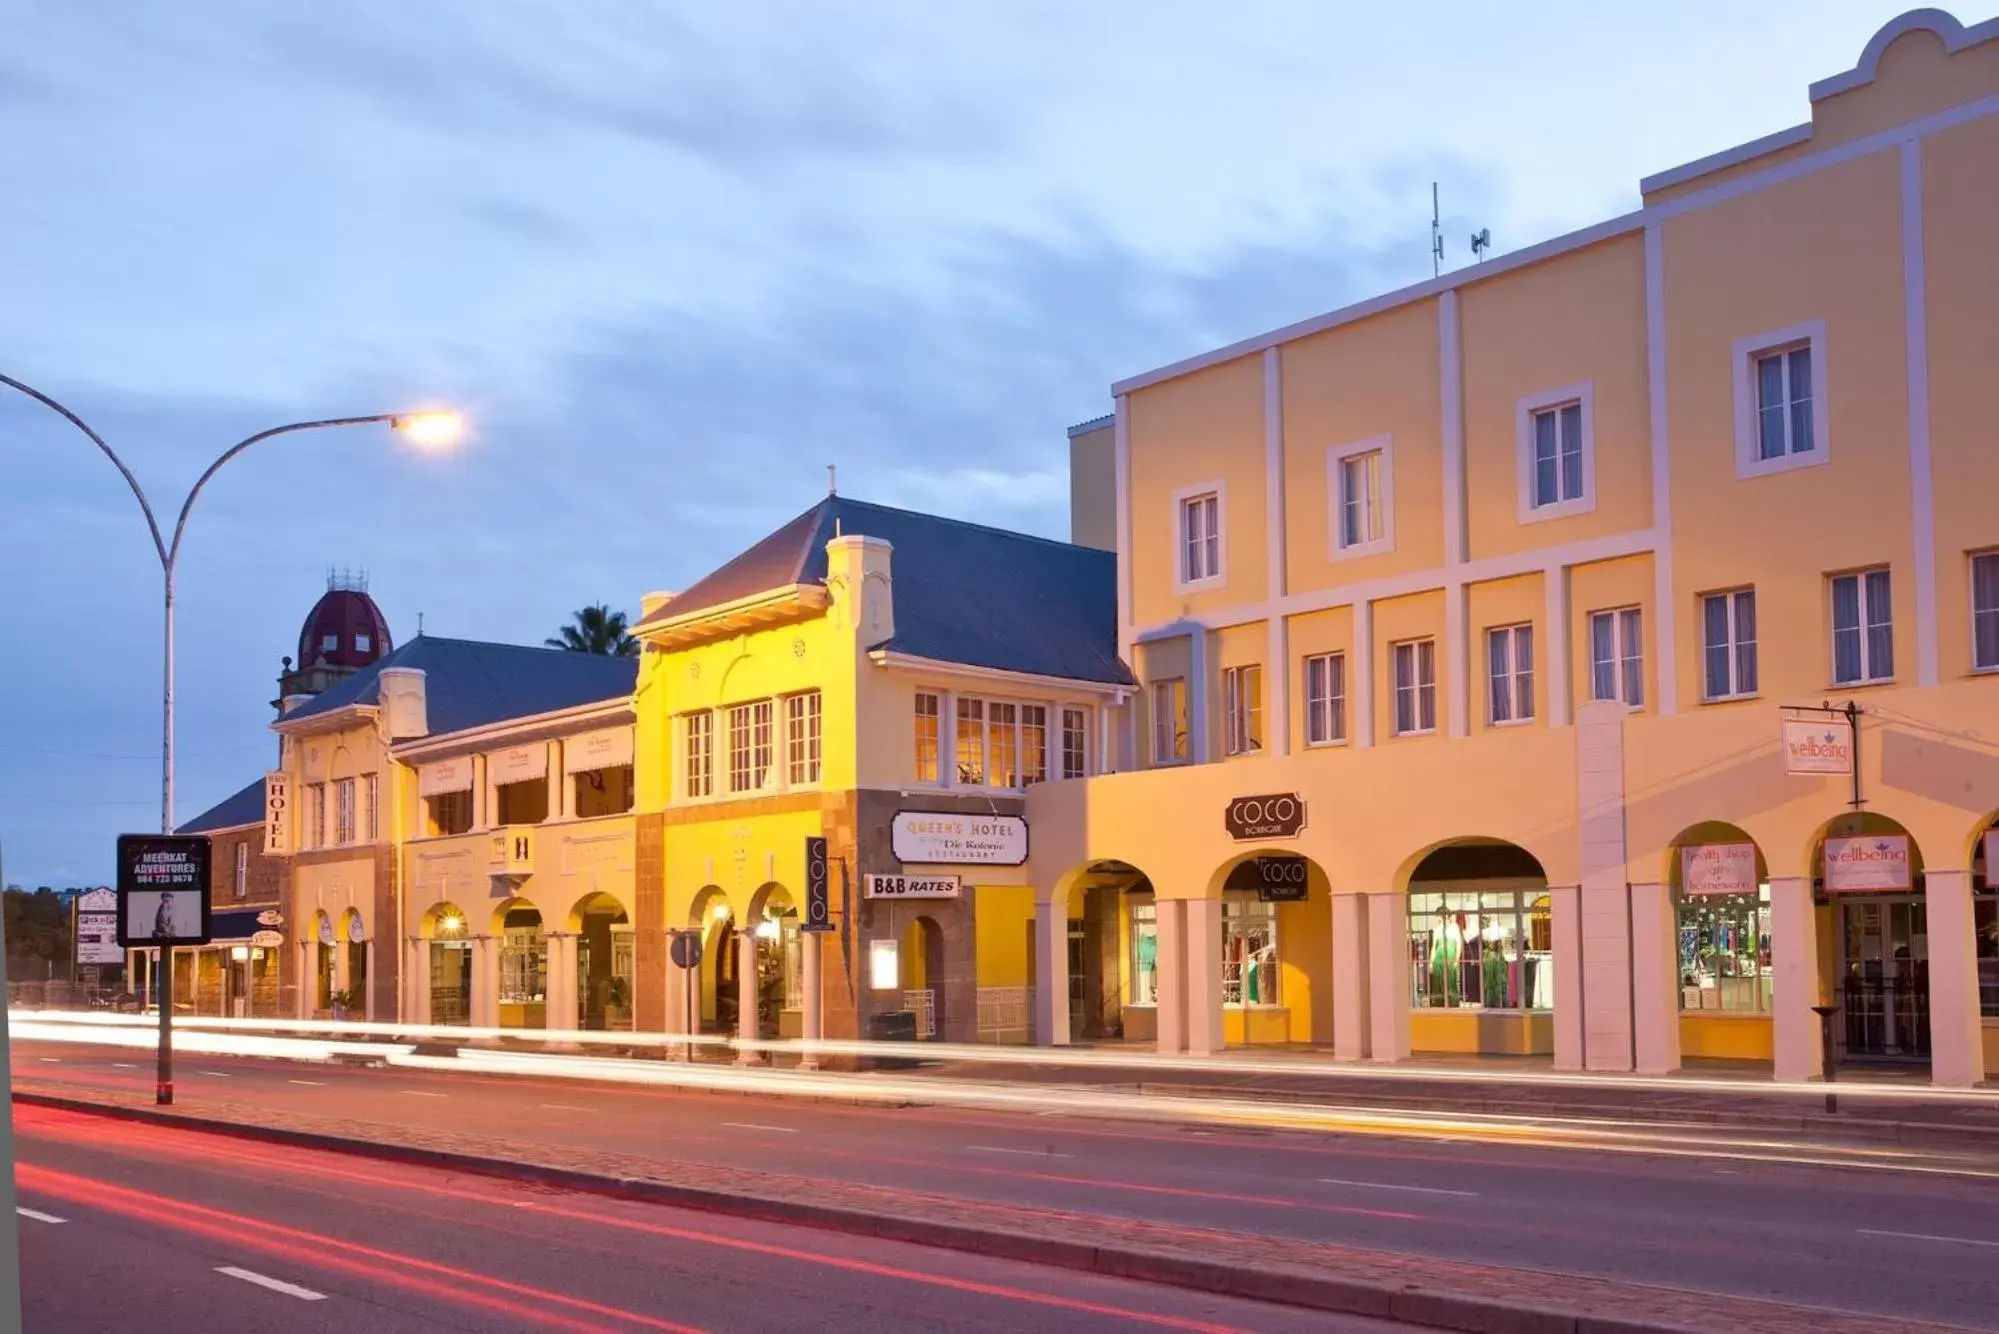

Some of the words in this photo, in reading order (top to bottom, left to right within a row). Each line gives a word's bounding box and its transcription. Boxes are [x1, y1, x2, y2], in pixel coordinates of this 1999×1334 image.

[1789, 736, 1847, 760] wellbeing
[270, 784, 285, 848] HOTEL
[1233, 798, 1295, 824] COCO
[907, 821, 962, 835] QUEEN'S
[971, 824, 1014, 836] HOTEL
[143, 852, 187, 862] MEERKAT
[1828, 846, 1906, 862] wellbeing
[134, 863, 196, 874] ADVENTURES
[1263, 863, 1304, 882] COCO
[811, 840, 825, 921] COCO
[875, 878, 905, 893] B&B
[909, 881, 955, 891] RATES
